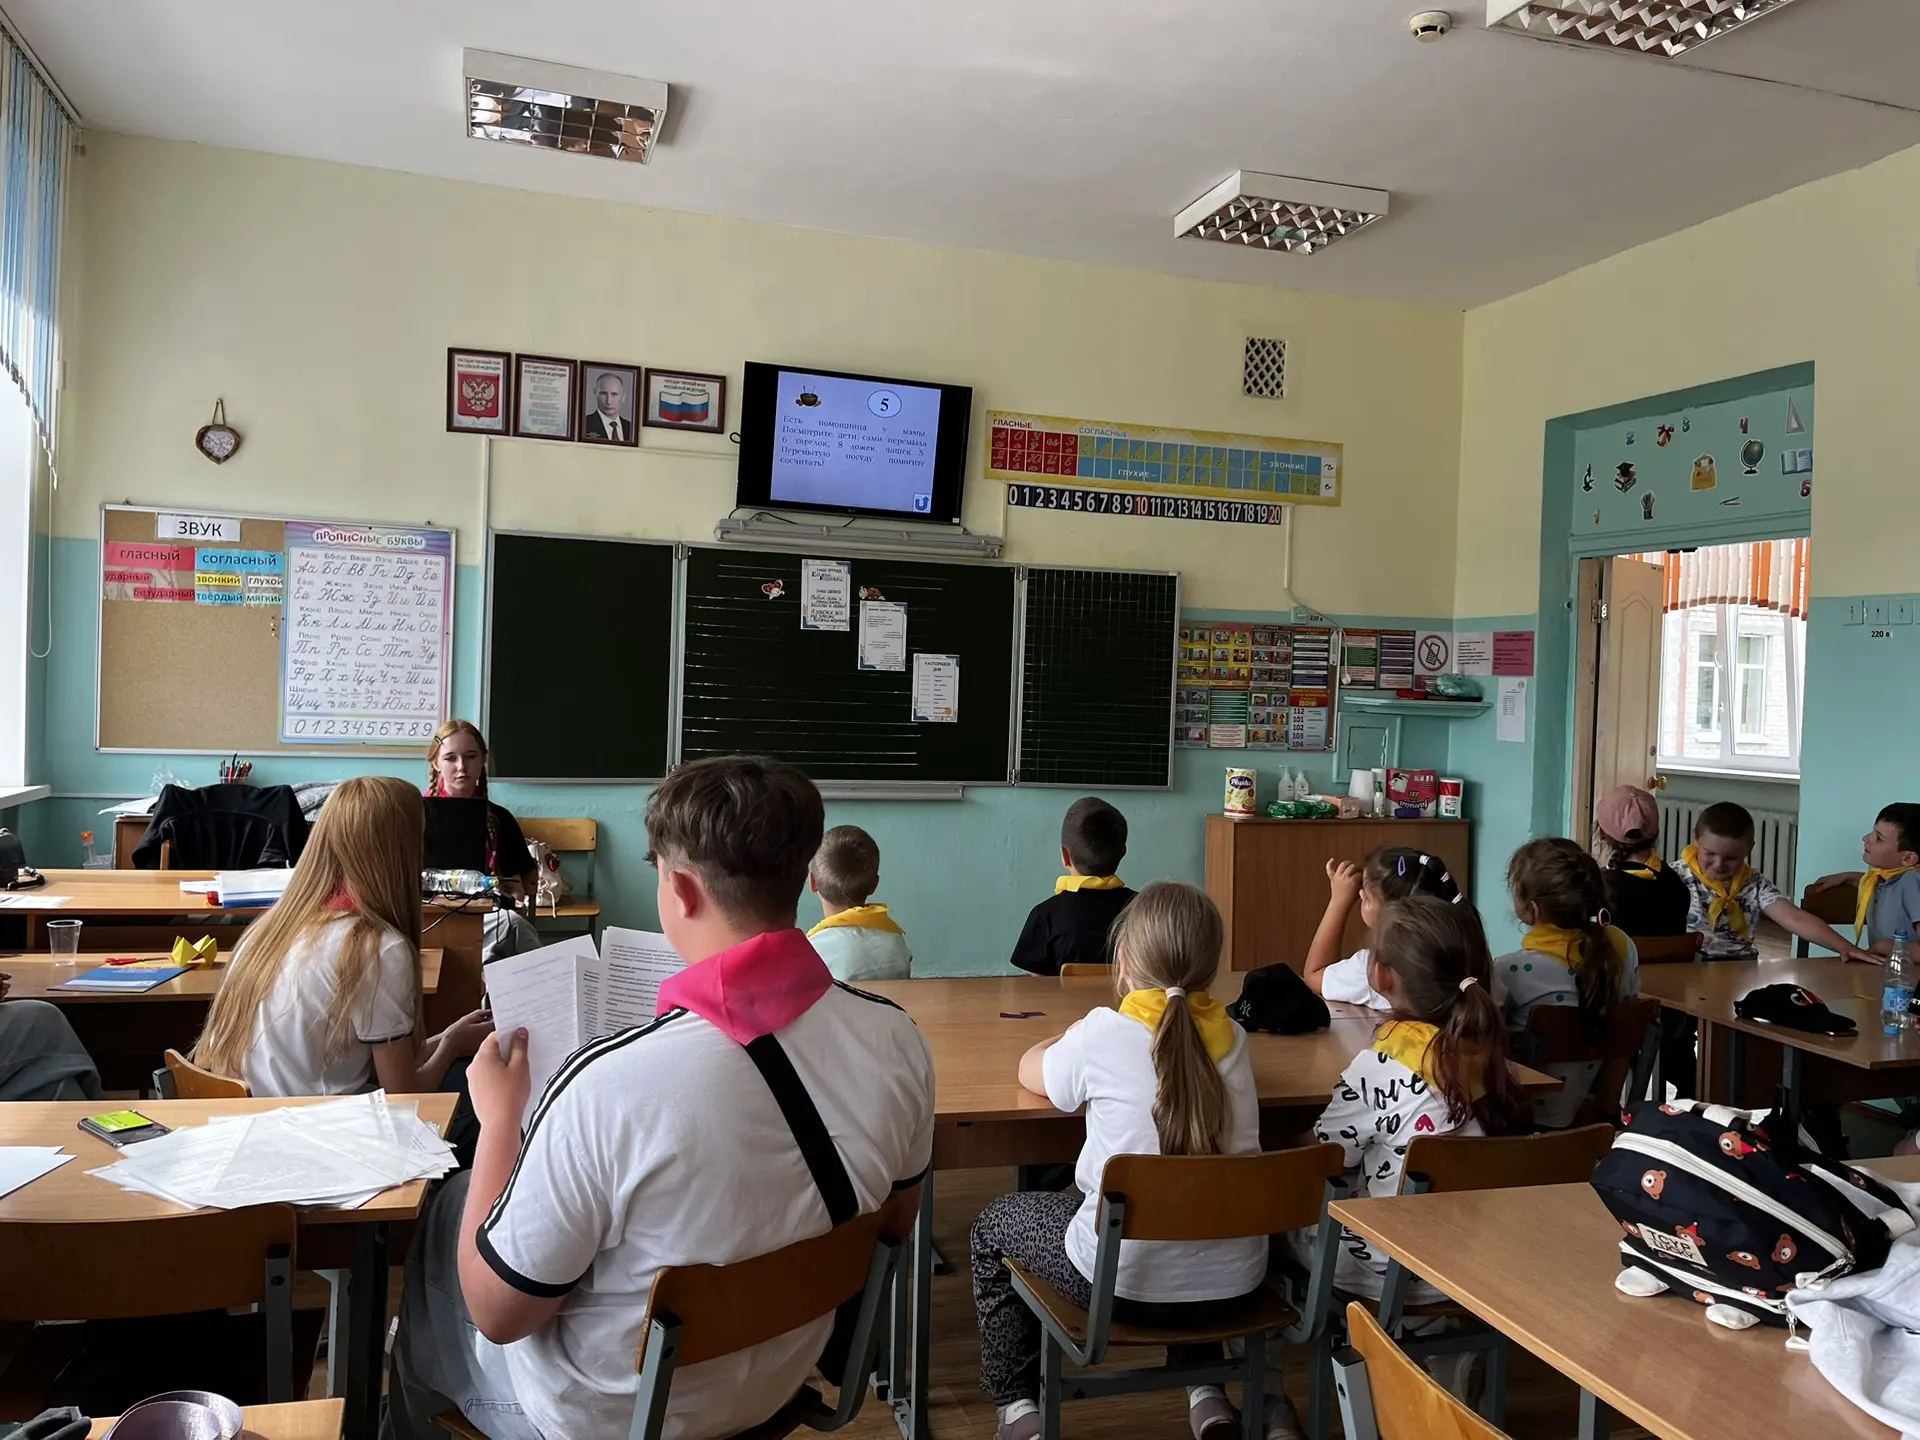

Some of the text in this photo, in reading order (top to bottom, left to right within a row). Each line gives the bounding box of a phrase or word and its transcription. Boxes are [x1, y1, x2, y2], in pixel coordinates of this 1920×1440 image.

[880, 398, 890, 412] 5
[783, 415, 803, 424] Есть
[818, 420, 867, 431] помощница
[993, 418, 1033, 429] ГЛАСНЫЕ
[1079, 426, 1129, 438] СОГЛАСНЫЕ
[795, 439, 830, 448] тарелок,
[837, 441, 843, 449] 8
[886, 447, 911, 455] чашек
[781, 446, 926, 466] Перемытую посуду помогите
[1269, 462, 1305, 471] ЗВОНКИЕ
[1118, 469, 1149, 478] ГЛУХИЕ
[1008, 485, 1281, 523] 0 1 2 3 4 5 6 7 8 9 10 11 12 13 14 15 16 17 18 19 20
[178, 521, 222, 537] ЗВУК
[316, 531, 424, 546] ПРОПИСНЫЕ БУКВЫ
[120, 549, 180, 561] гласный
[202, 554, 277, 567] согласный
[104, 572, 150, 582] ударный
[196, 574, 283, 587] звонкий глухой
[134, 588, 195, 600] безударный
[196, 590, 243, 603] твёрдый
